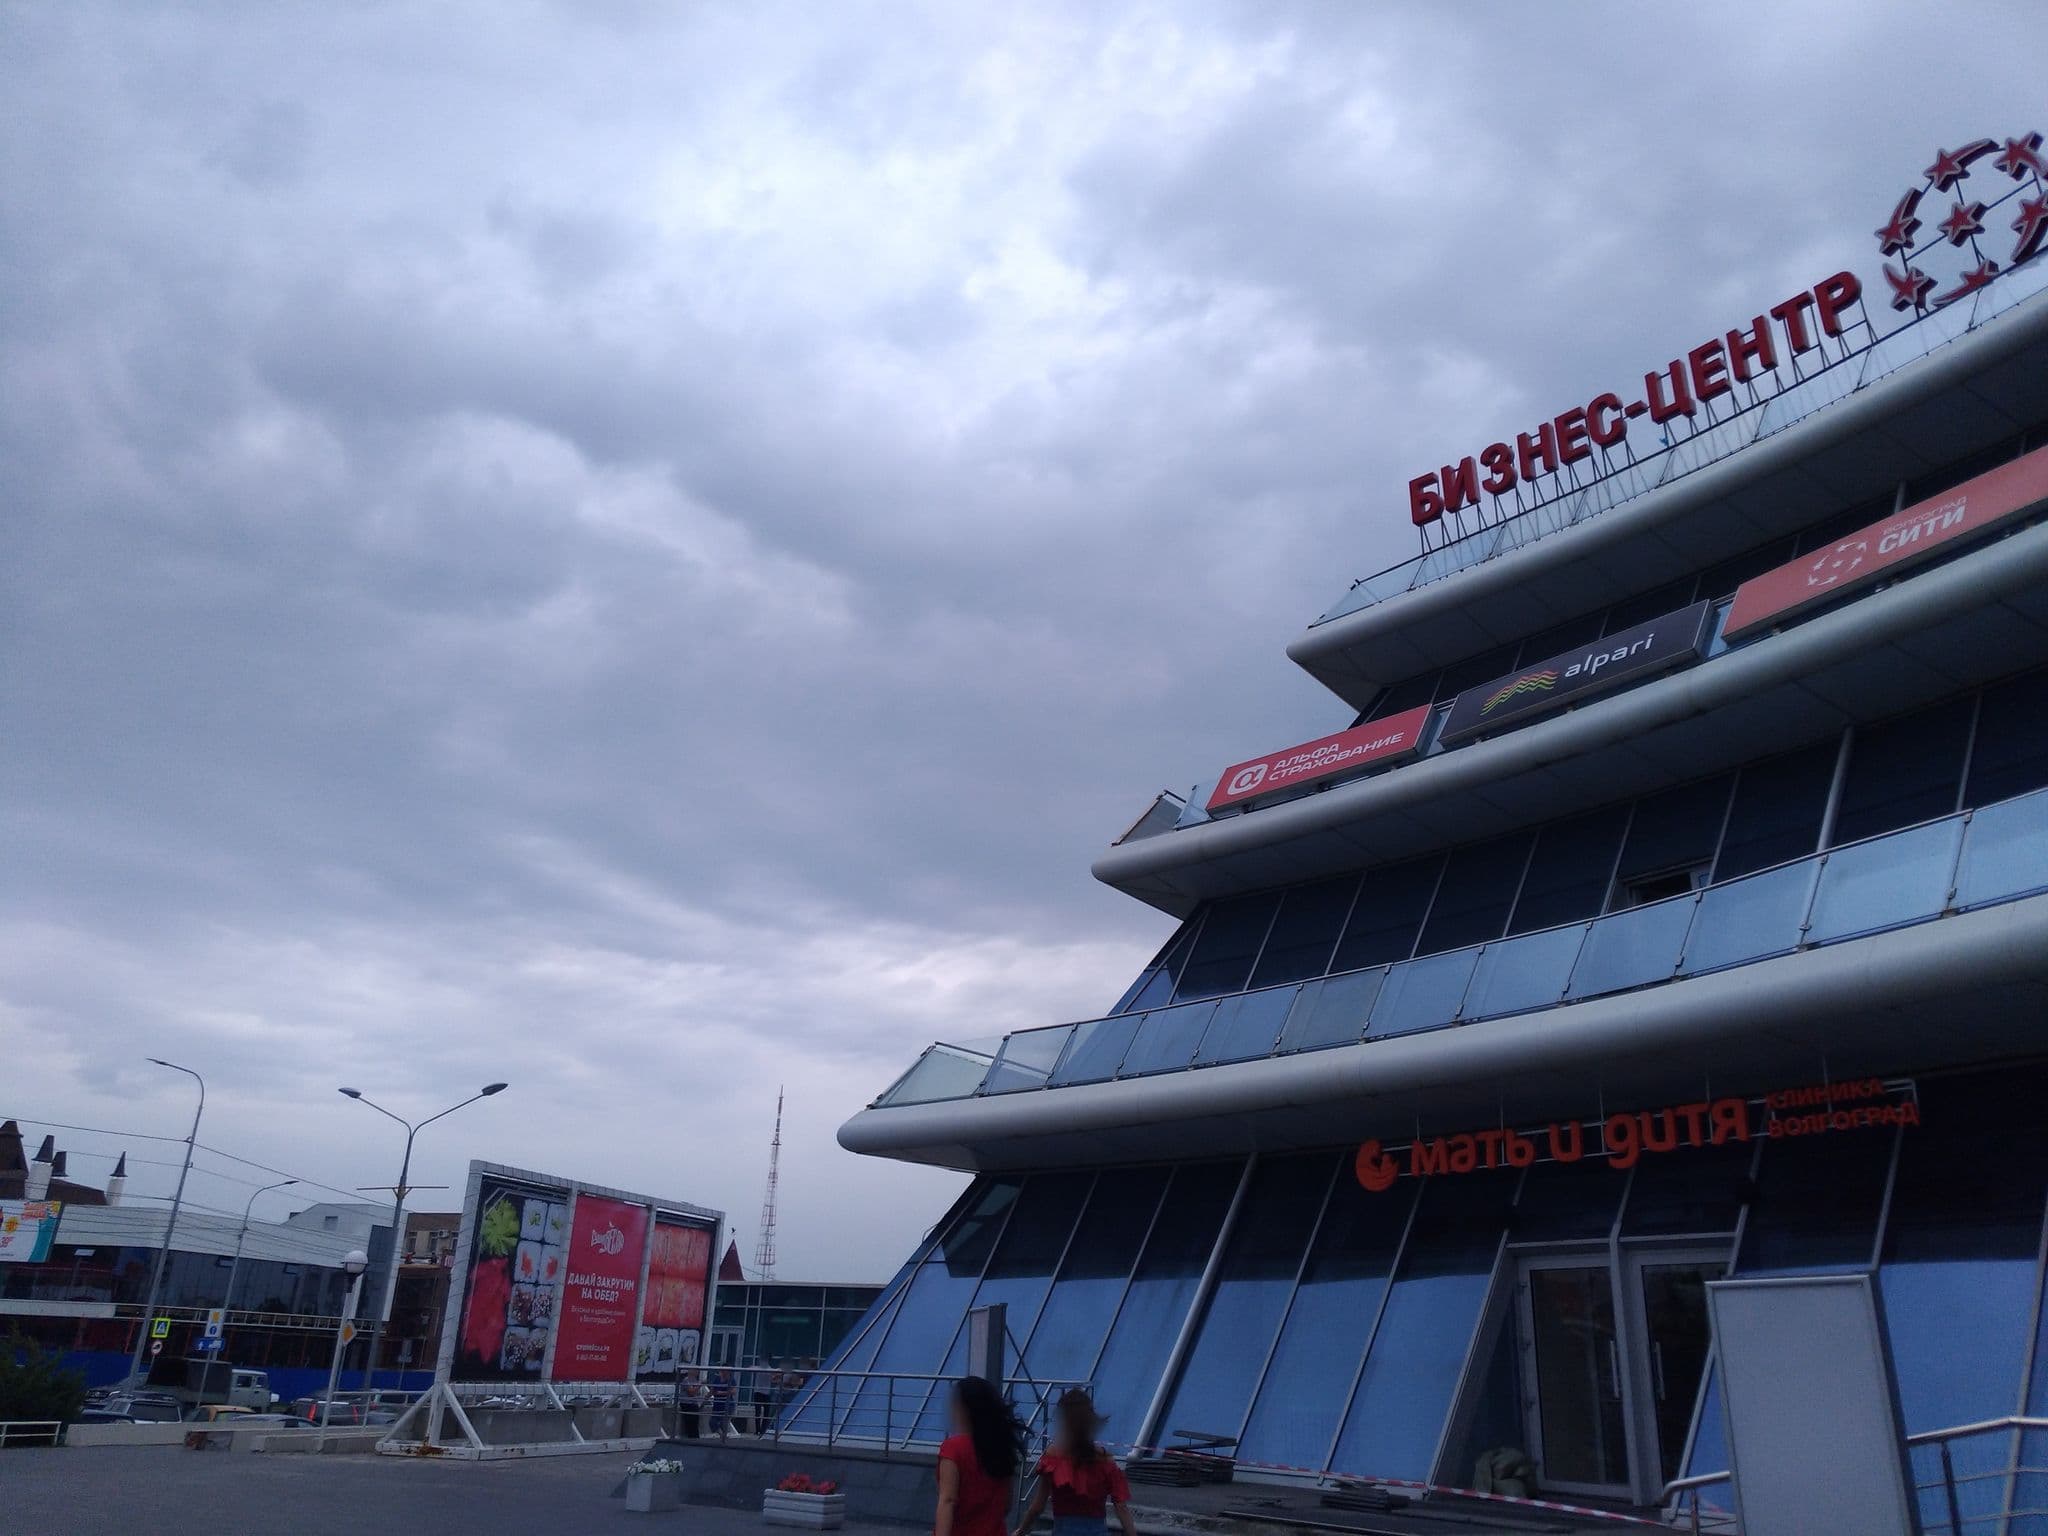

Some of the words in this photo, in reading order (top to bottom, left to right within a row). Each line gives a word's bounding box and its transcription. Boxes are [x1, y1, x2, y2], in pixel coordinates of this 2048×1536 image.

[1408, 270, 1862, 526] БИЗНЕС-ЦЕНТР
[1878, 505, 1966, 555] СИТИ
[1564, 633, 1655, 678] alpari
[1268, 732, 1404, 781] СТРАХОВАНИЕ
[1274, 743, 1340, 770] АЛЬФА
[1766, 1077, 1885, 1110] КЛИНИКА
[1410, 1128, 1537, 1177] мать
[1603, 1098, 1749, 1170] дитя
[1768, 1102, 1920, 1138] ВОЛГОГРАД
[567, 1272, 596, 1287] ДАВАЙ
[596, 1276, 635, 1291] ЗАКРУТИМ
[581, 1288, 592, 1300] НА
[594, 1289, 620, 1303] ОБЕД?
